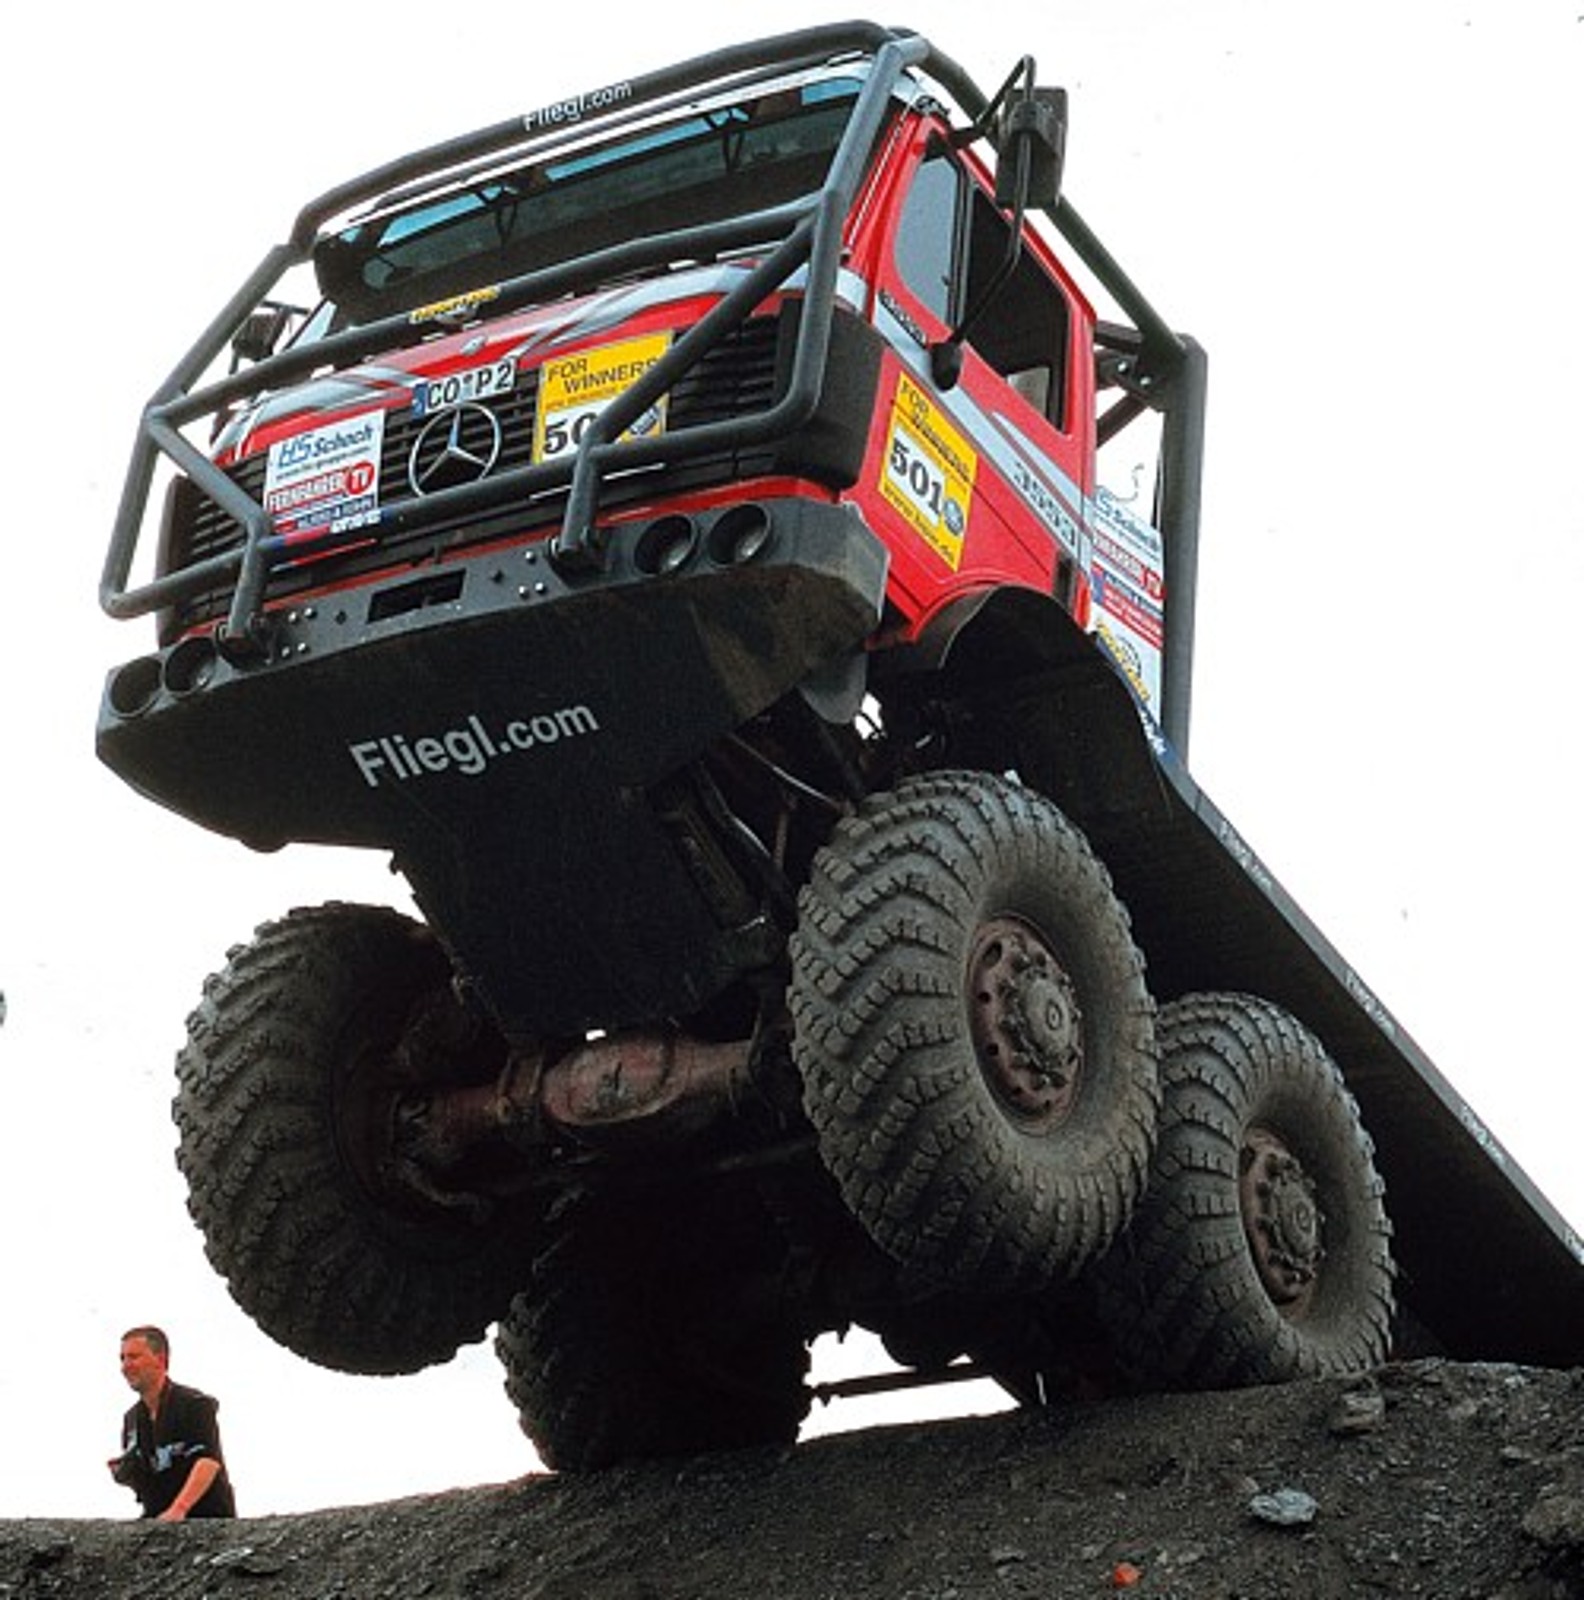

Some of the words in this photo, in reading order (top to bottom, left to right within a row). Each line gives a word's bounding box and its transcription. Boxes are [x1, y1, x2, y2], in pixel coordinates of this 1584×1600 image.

[522, 82, 633, 132] Fliegl.com
[427, 377, 461, 410] CO
[547, 358, 588, 382] FOR
[543, 411, 600, 455] 50
[890, 437, 942, 515] 501
[349, 704, 600, 787] Fliegl.com
